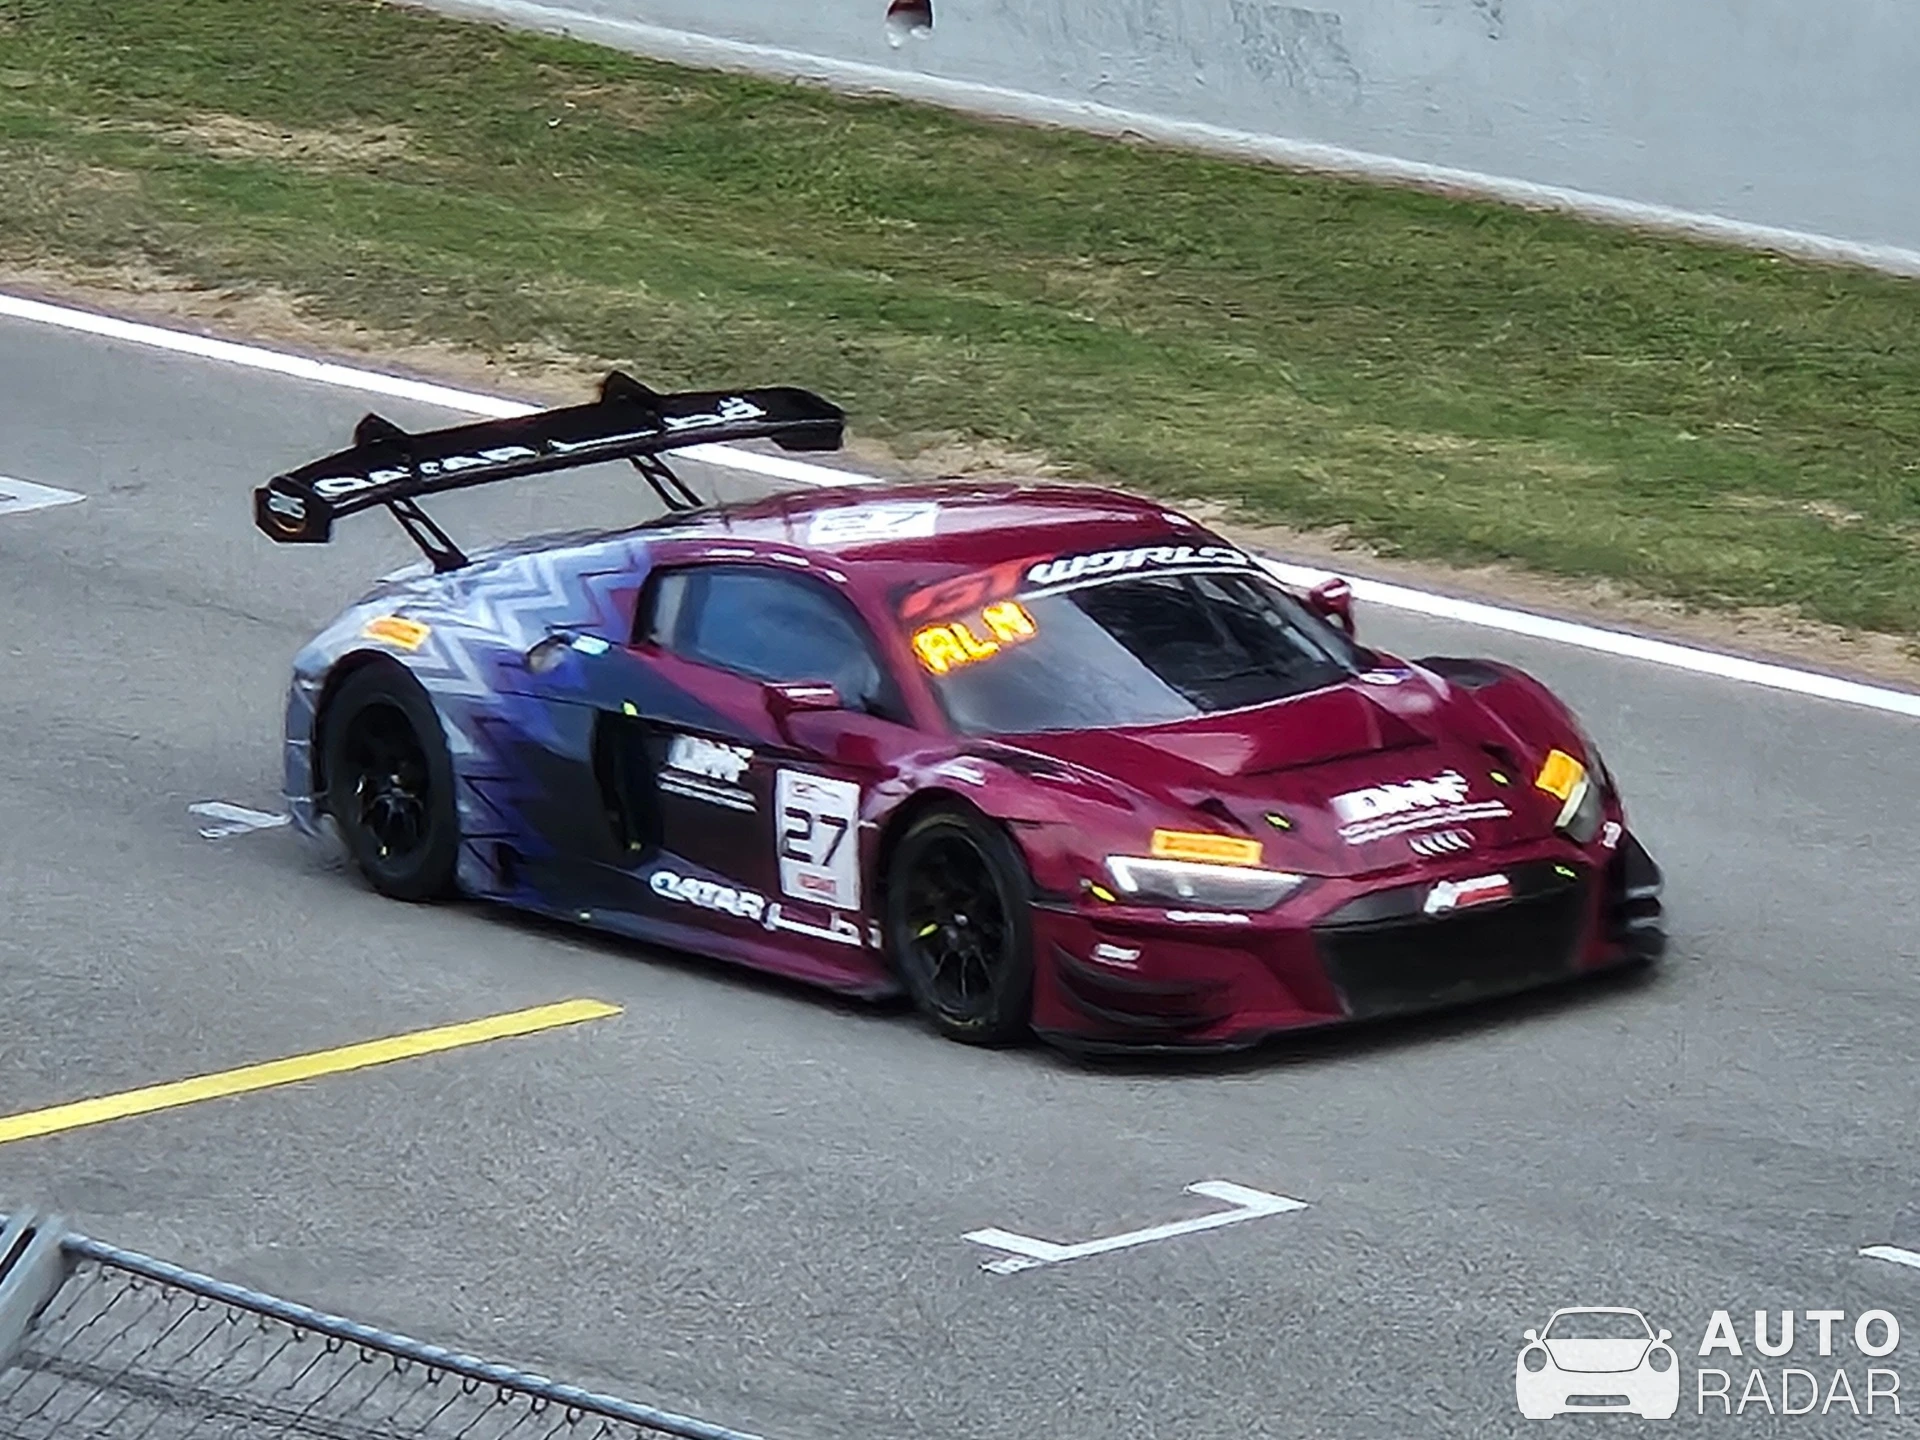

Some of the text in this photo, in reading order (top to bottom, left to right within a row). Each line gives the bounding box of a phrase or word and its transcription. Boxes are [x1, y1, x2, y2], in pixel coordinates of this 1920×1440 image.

[1027, 545, 1248, 585] WORLD
[912, 600, 1038, 675] ALN
[782, 806, 849, 868] 27
